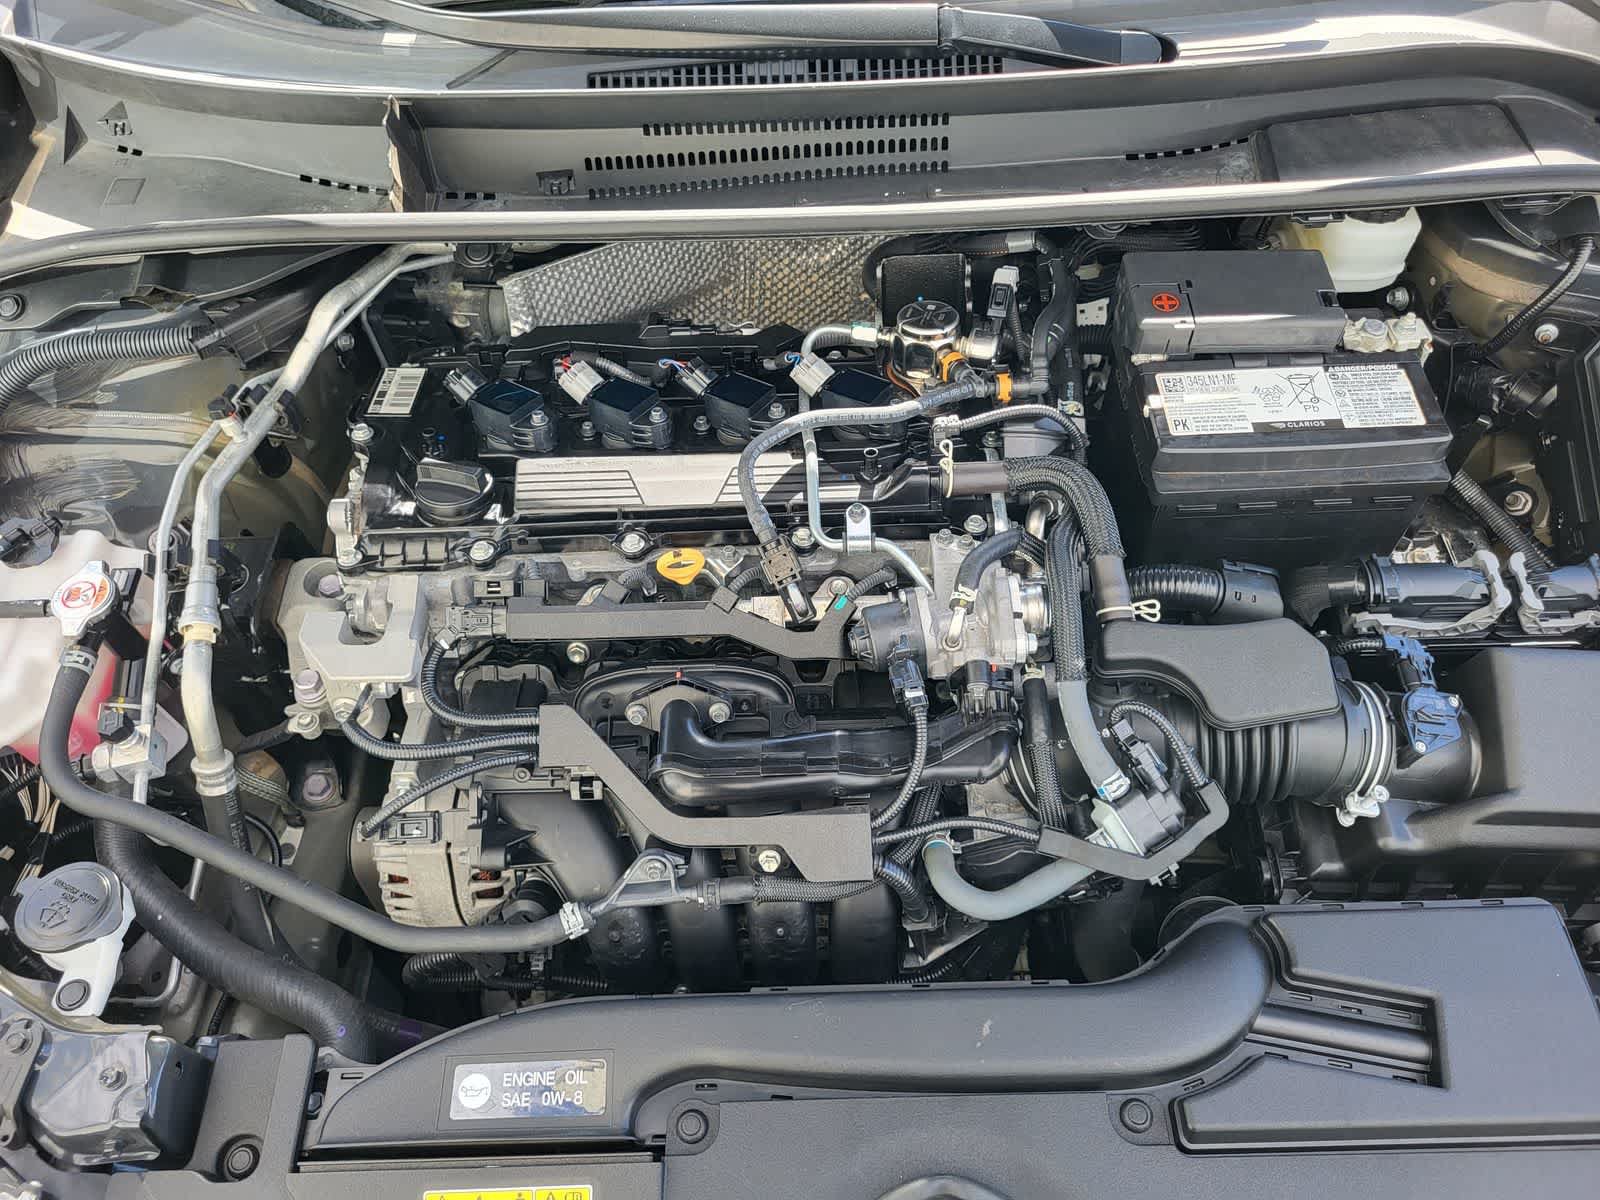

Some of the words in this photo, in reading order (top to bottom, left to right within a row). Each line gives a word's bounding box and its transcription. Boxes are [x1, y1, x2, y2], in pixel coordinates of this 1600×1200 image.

[1186, 373, 1237, 387] 345LN1-MF
[1303, 404, 1319, 412] Pb
[1173, 419, 1190, 431] PK
[502, 1071, 556, 1087] ENGINE
[565, 1070, 588, 1085] OIL
[502, 1092, 531, 1107] SAE
[542, 1090, 583, 1106] 0W-8
